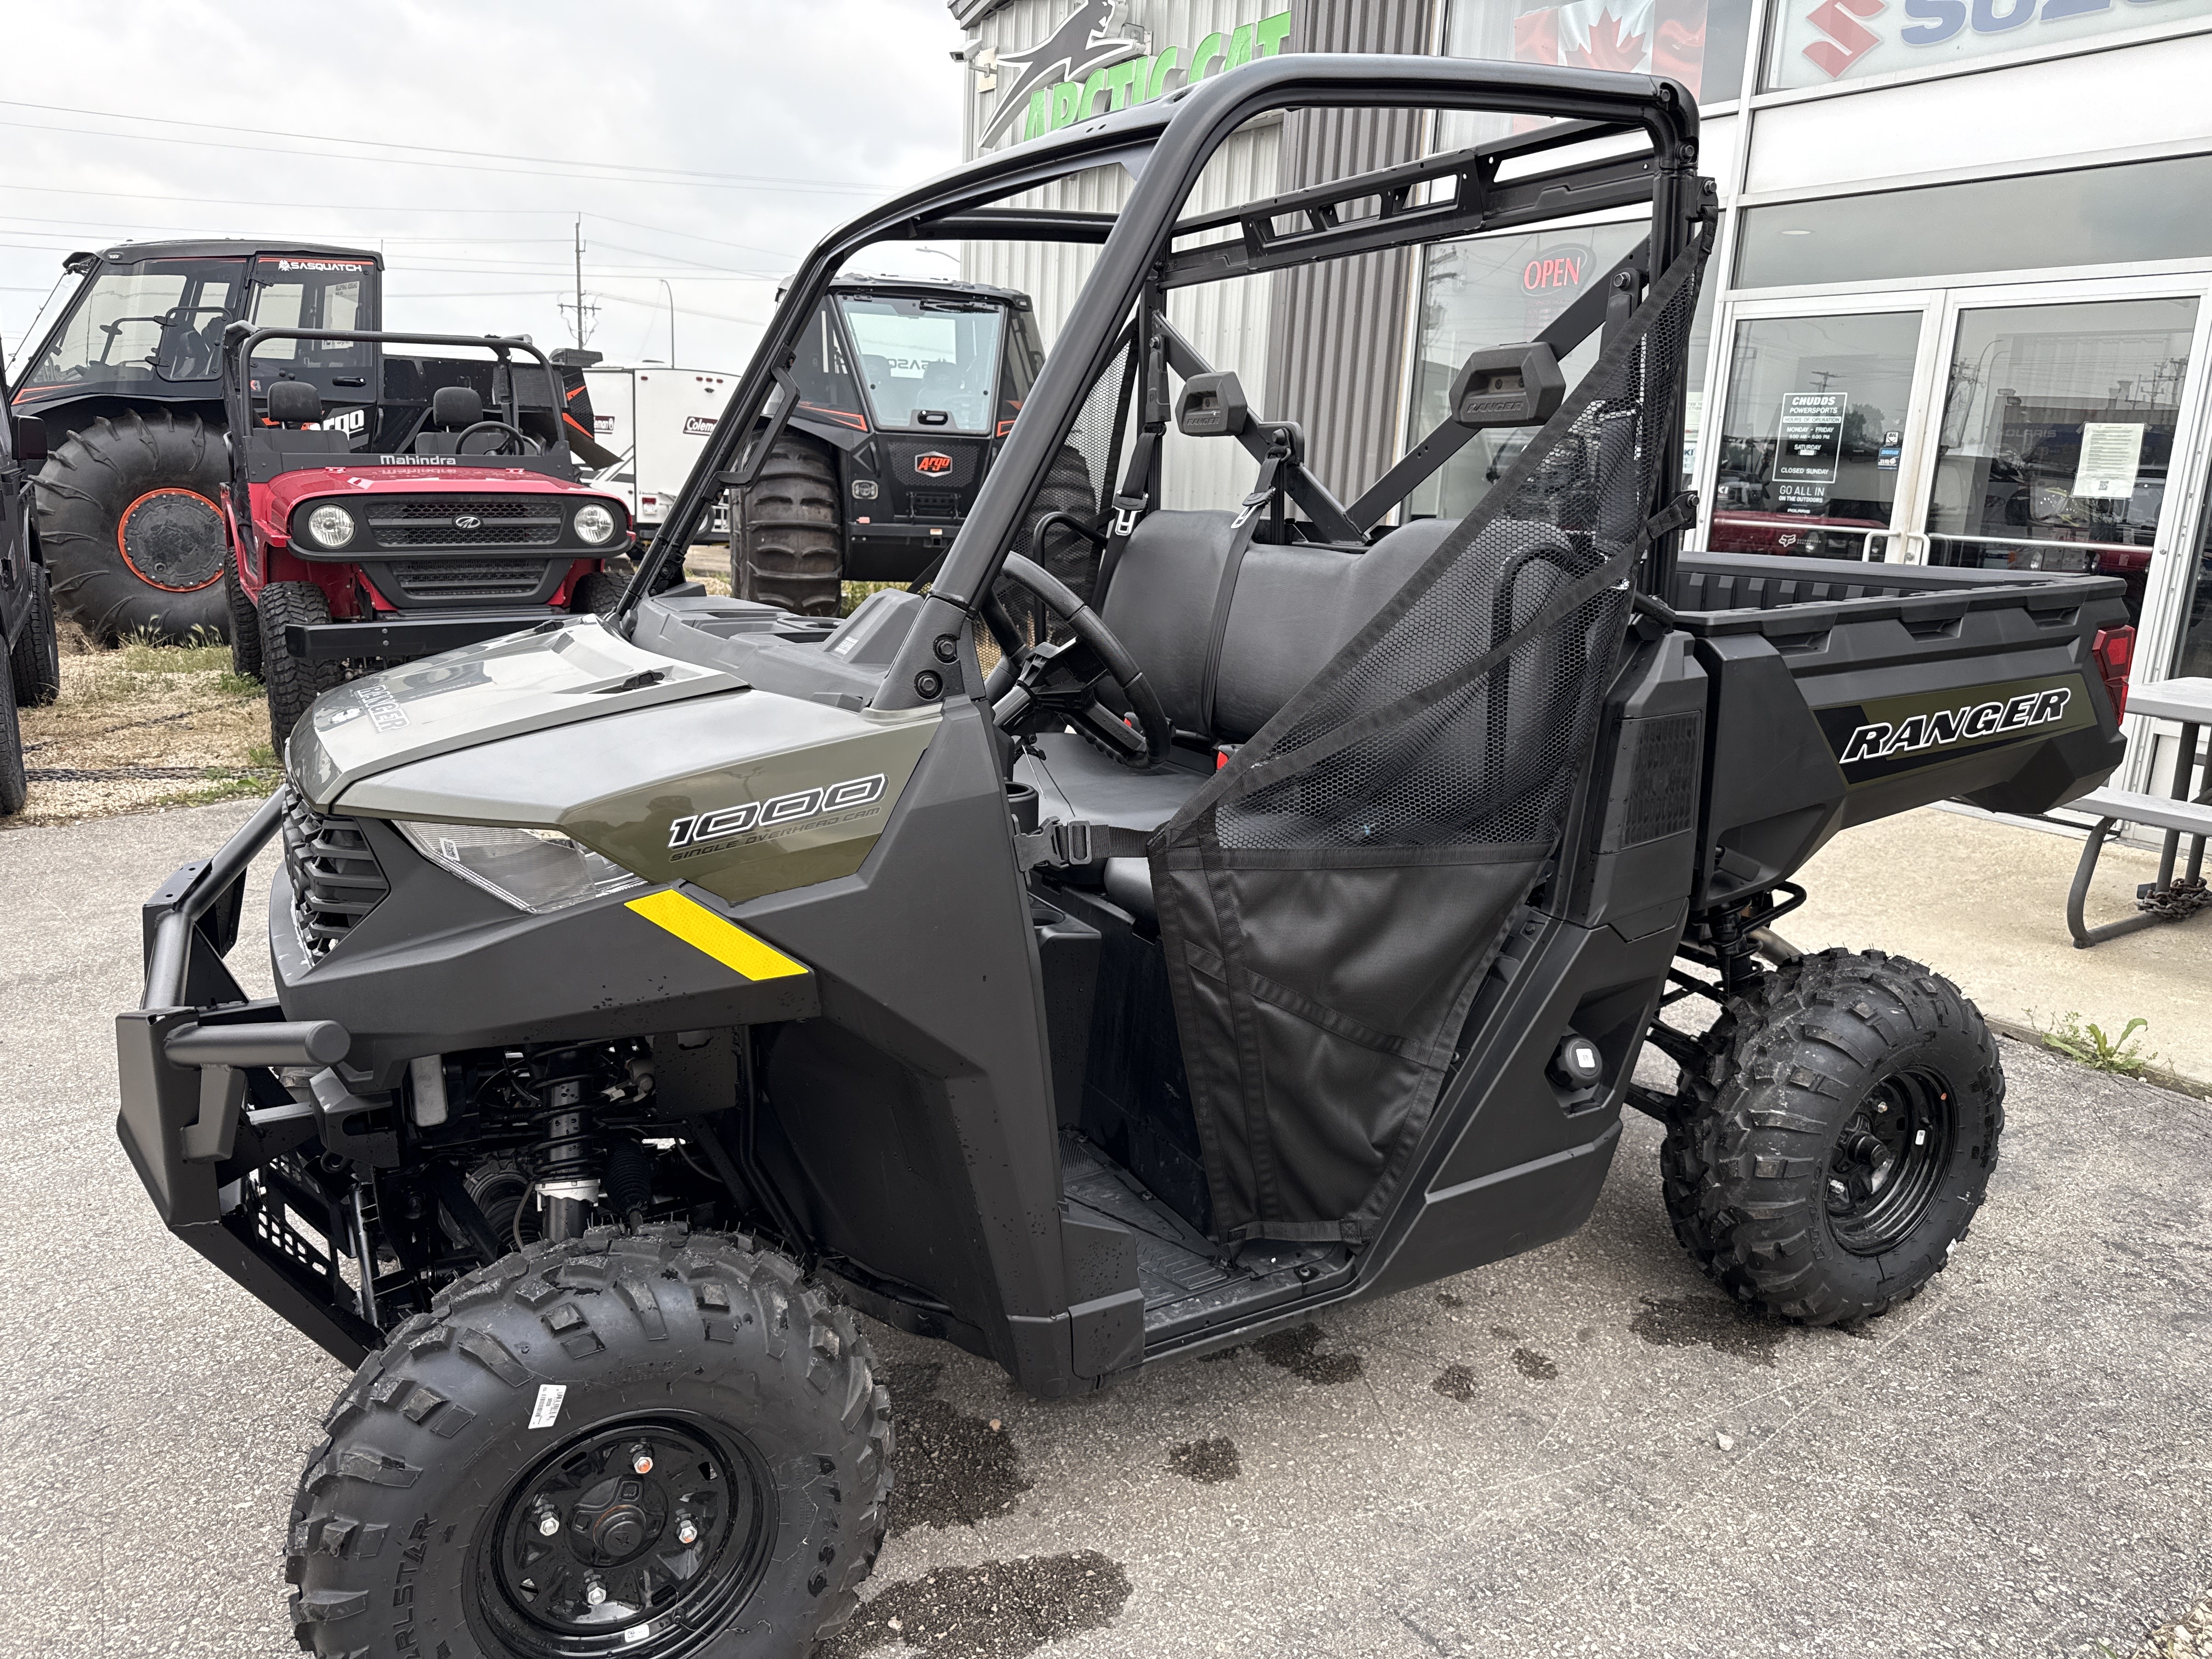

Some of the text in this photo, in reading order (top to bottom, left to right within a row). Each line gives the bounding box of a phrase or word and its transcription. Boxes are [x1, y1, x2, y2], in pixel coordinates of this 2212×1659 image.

[291, 262, 362, 272] SASQUATCH
[1524, 257, 1581, 290] OPEN
[1466, 400, 1523, 414] RANGER
[1792, 396, 1836, 405] CHUDDS
[310, 410, 364, 441] rgo
[594, 416, 608, 430] eman
[686, 417, 716, 432] Colem
[1187, 417, 1220, 426] RANGER
[2004, 429, 2057, 438] OLARIS
[380, 455, 456, 465] Mahindra
[918, 457, 950, 471] Argo
[1780, 485, 1825, 496] GO ALL IN
[357, 684, 411, 732] RANGER
[1839, 687, 2071, 764] RANGER
[668, 772, 890, 849] 1000
[670, 807, 881, 861] SINGLE OVERHEAD CAM
